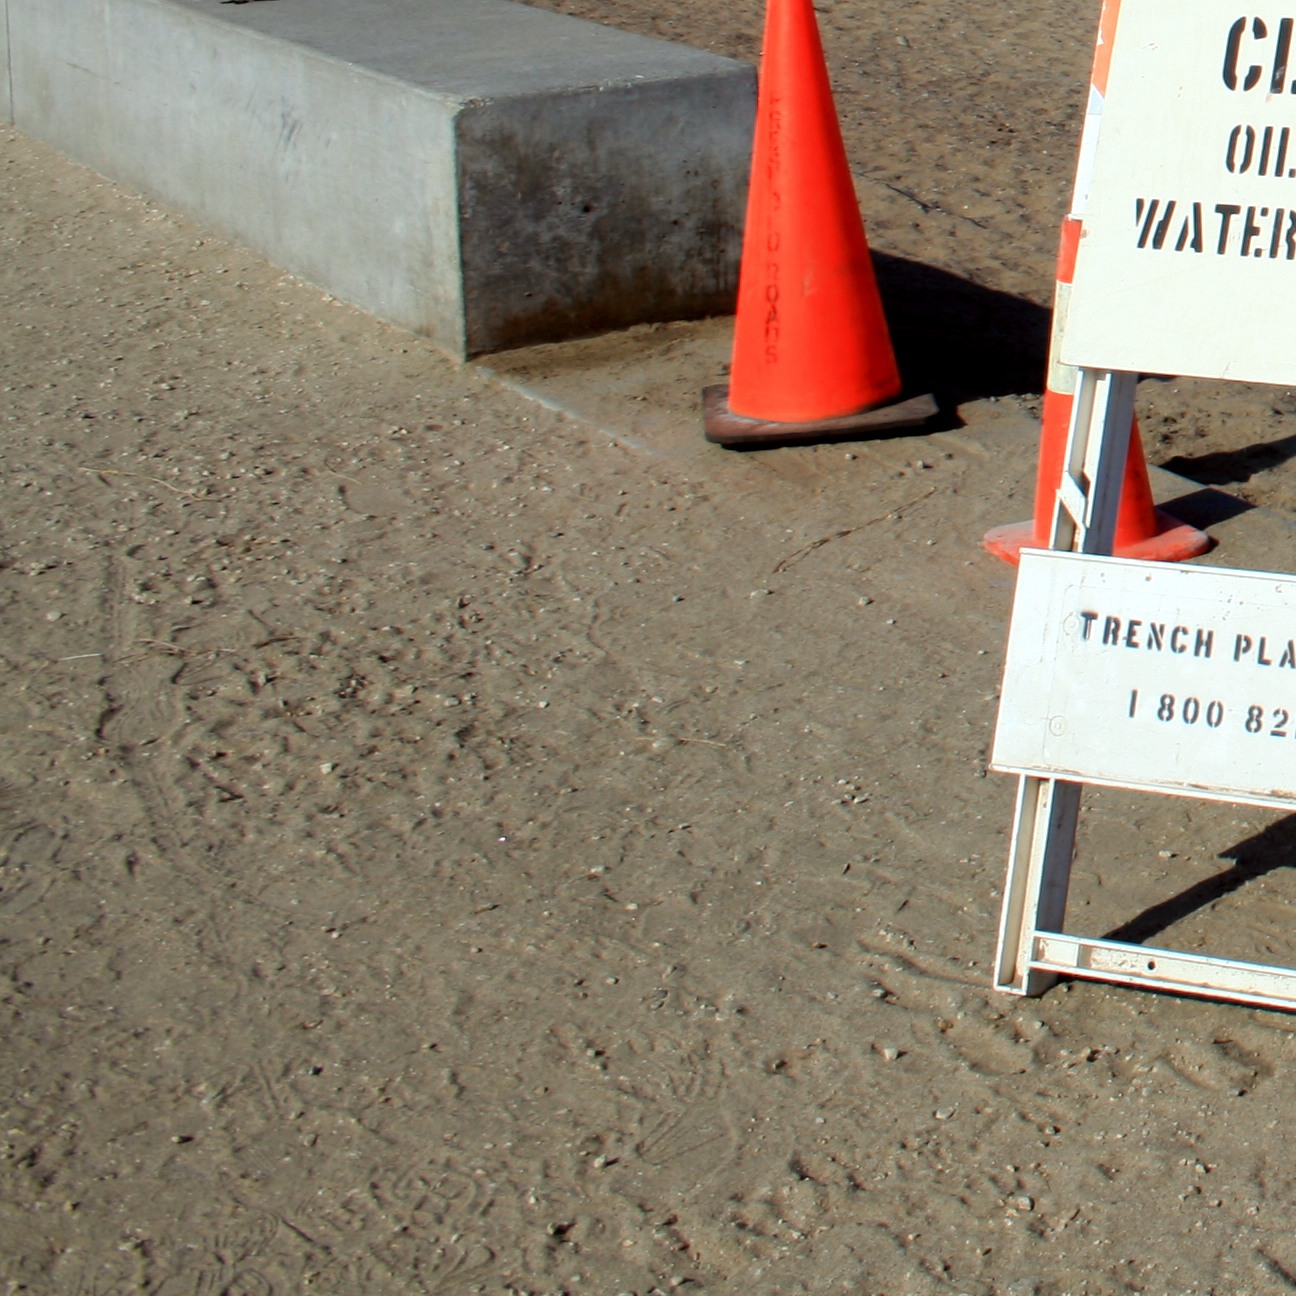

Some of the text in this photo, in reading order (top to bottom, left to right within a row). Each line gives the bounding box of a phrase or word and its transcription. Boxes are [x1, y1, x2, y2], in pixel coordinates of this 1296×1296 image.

[1225, 124, 1296, 178] OIL
[1081, 611, 1213, 658] TRENCH
[1157, 694, 1223, 727] 800
